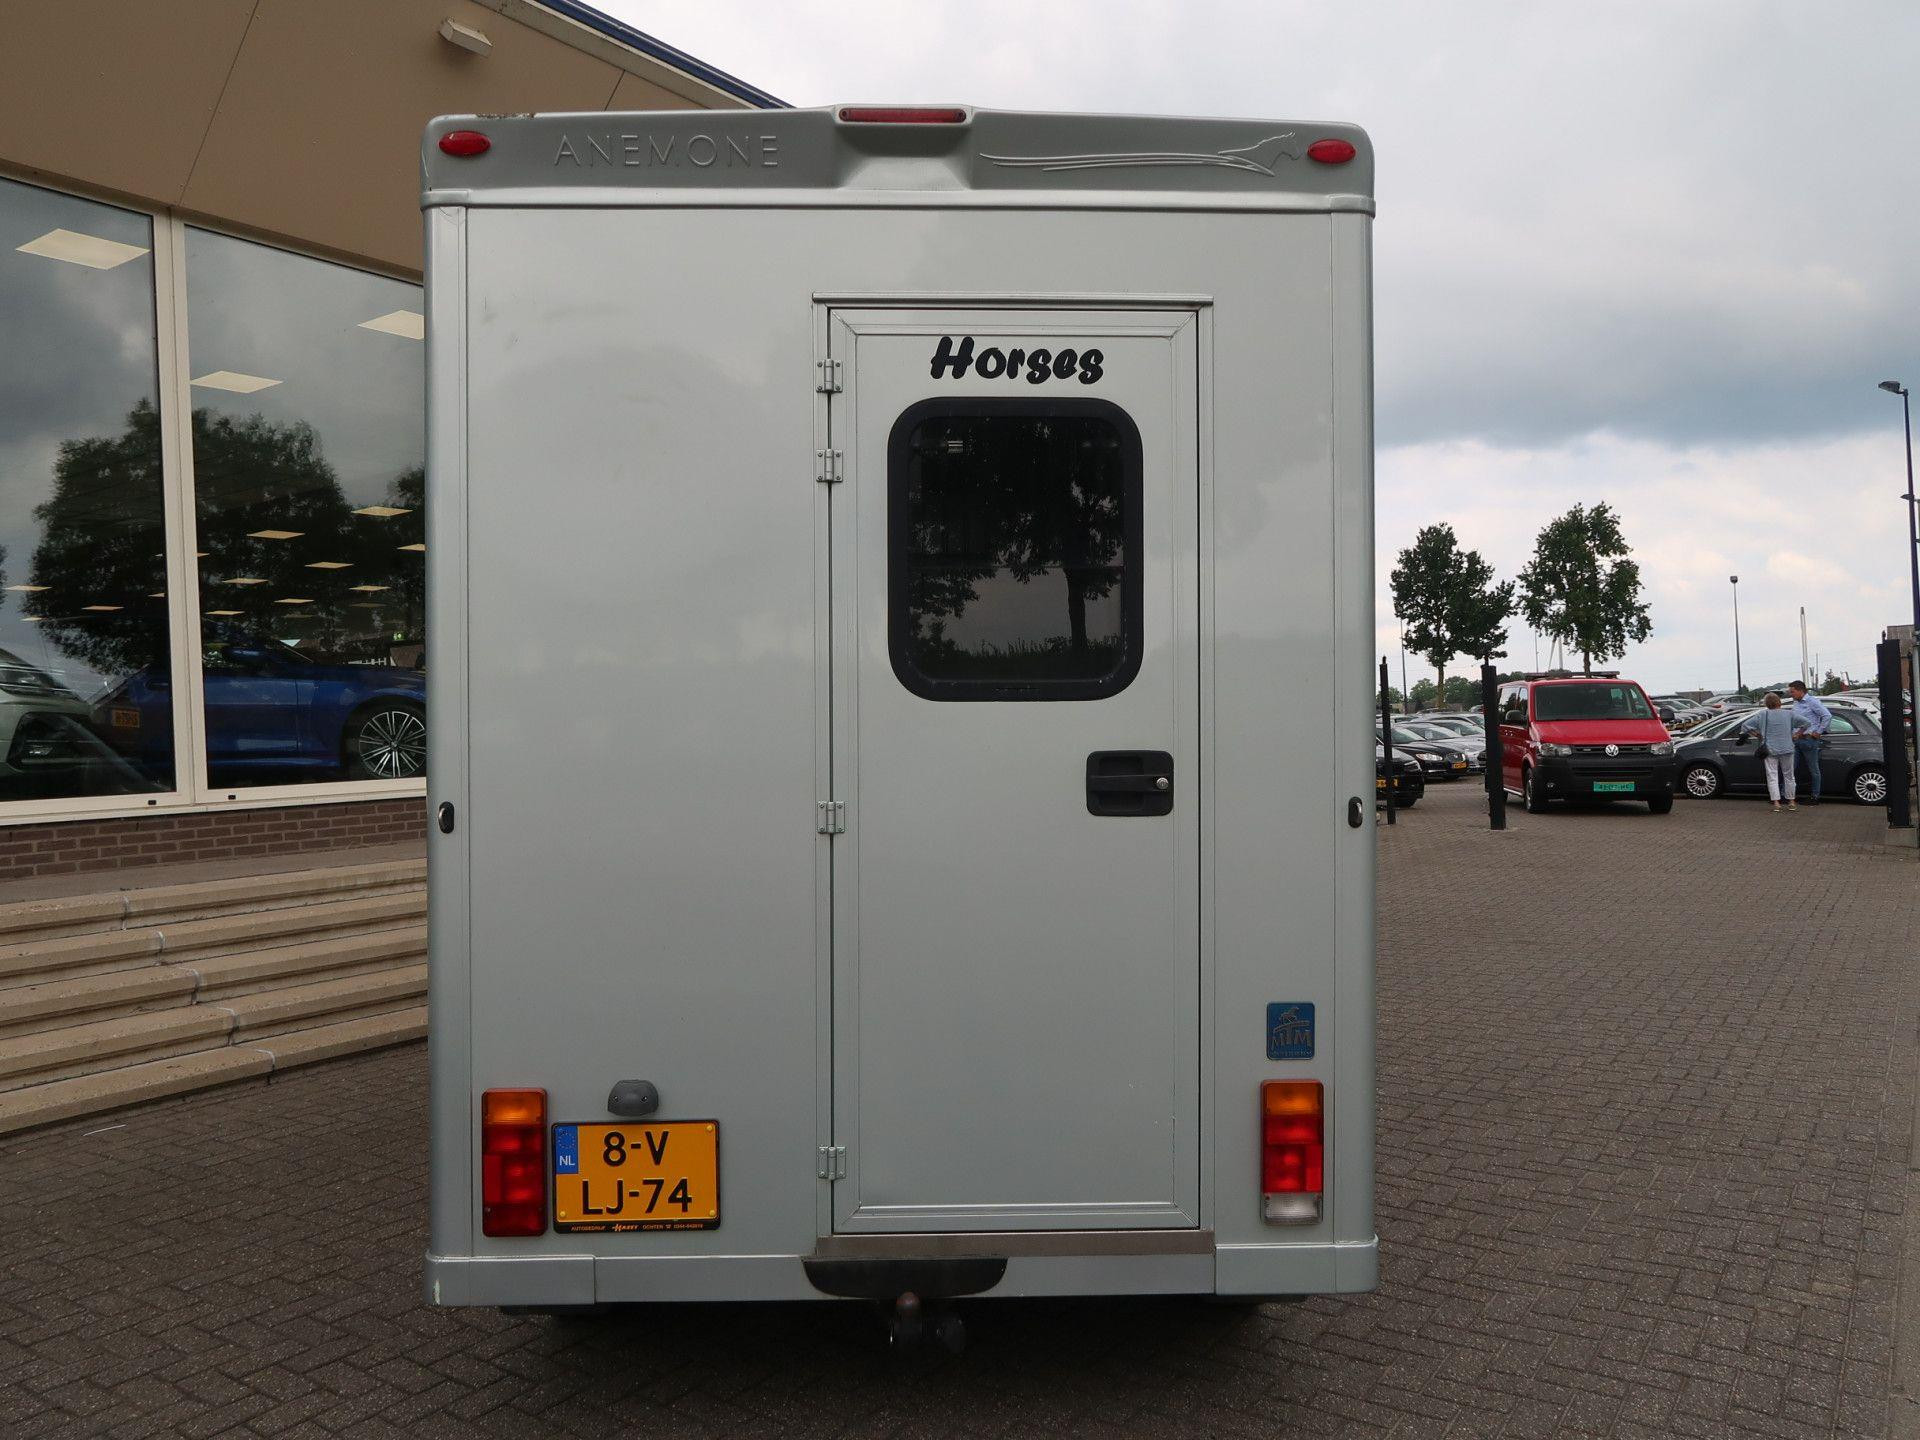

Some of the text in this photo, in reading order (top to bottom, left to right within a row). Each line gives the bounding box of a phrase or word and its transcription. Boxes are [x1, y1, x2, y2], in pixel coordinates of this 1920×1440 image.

[554, 134, 778, 167] ANEMONE
[930, 335, 1105, 385] Horses
[559, 1155, 576, 1166] NL
[603, 1130, 669, 1167] 8-V
[582, 1178, 693, 1215] LJ-74
